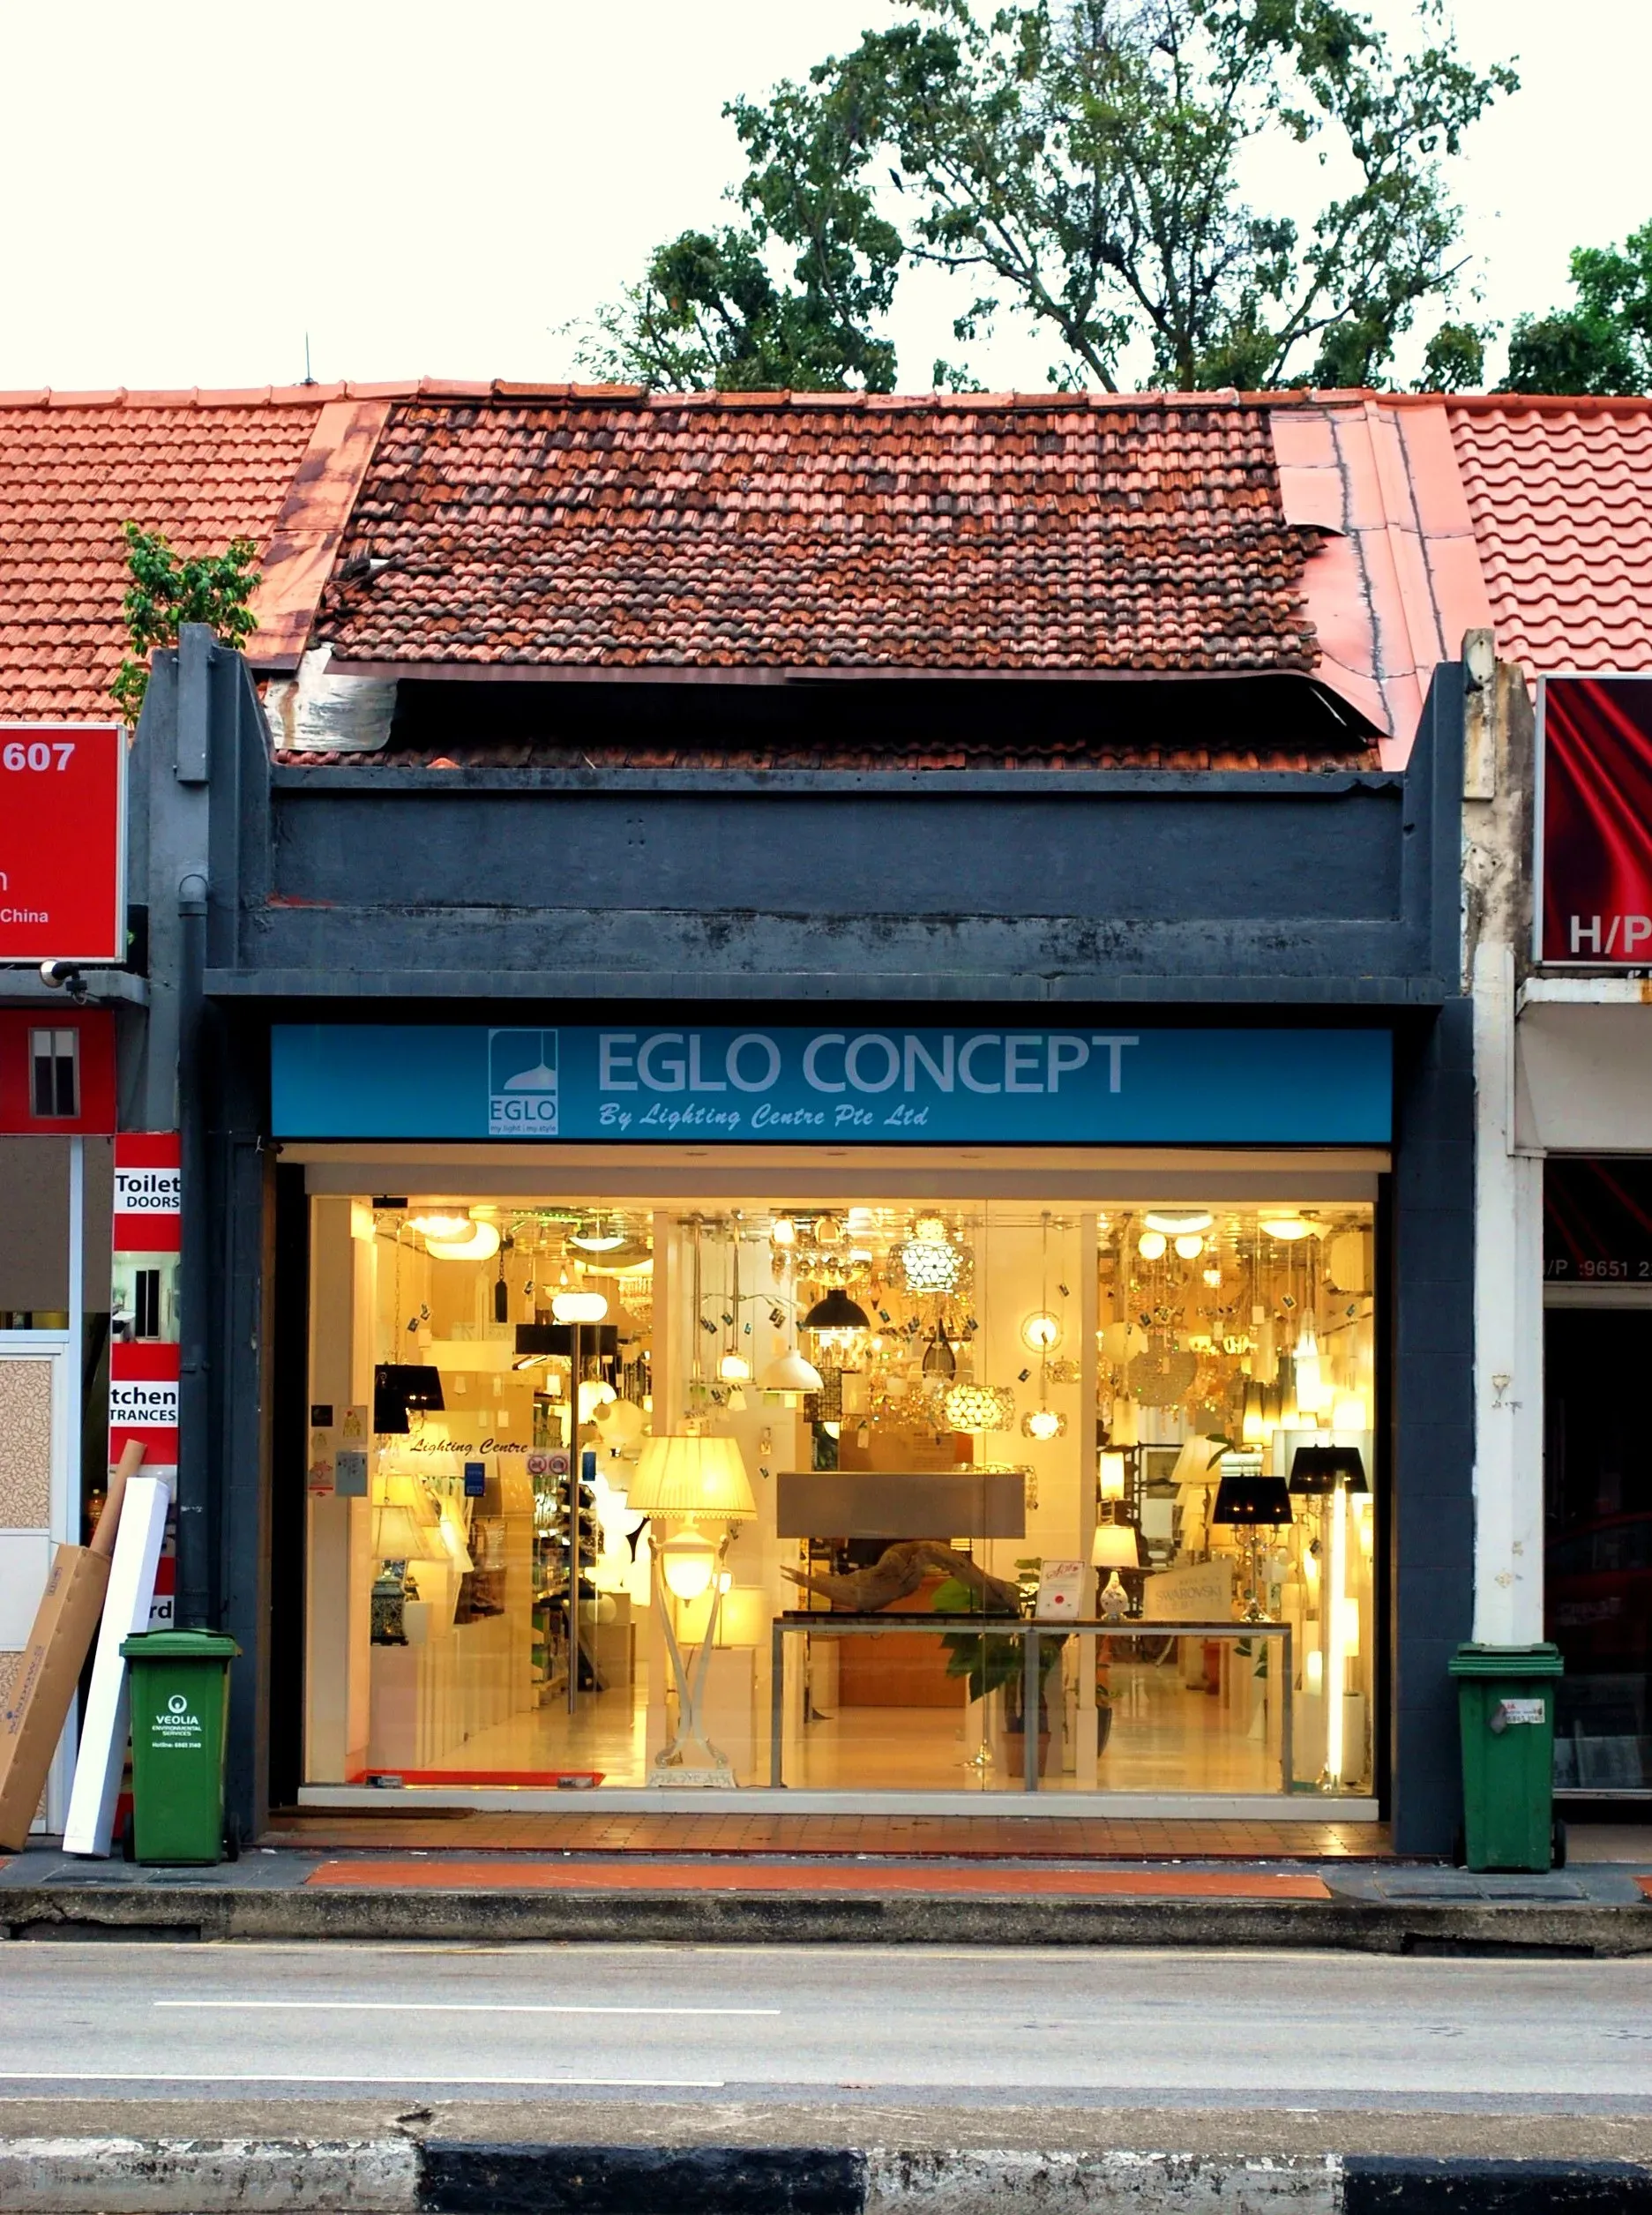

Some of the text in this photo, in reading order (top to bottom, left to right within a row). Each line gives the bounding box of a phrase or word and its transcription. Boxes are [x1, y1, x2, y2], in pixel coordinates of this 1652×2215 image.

[3, 742, 76, 772] 607
[0, 908, 49, 923] China
[1570, 915, 1652, 954] H/P
[599, 1033, 1140, 1094] EGLO CONCEPT
[490, 1100, 557, 1121] EGLO
[599, 1102, 929, 1132] By Lighting Centre Pte Ltd
[115, 1174, 182, 1193] Toilet
[127, 1196, 180, 1209] DOORS
[111, 1386, 176, 1405] tchen
[110, 1410, 176, 1421] TRANCES
[409, 1438, 529, 1456] Lighting Centre
[155, 1716, 199, 1725] VEOLIA
